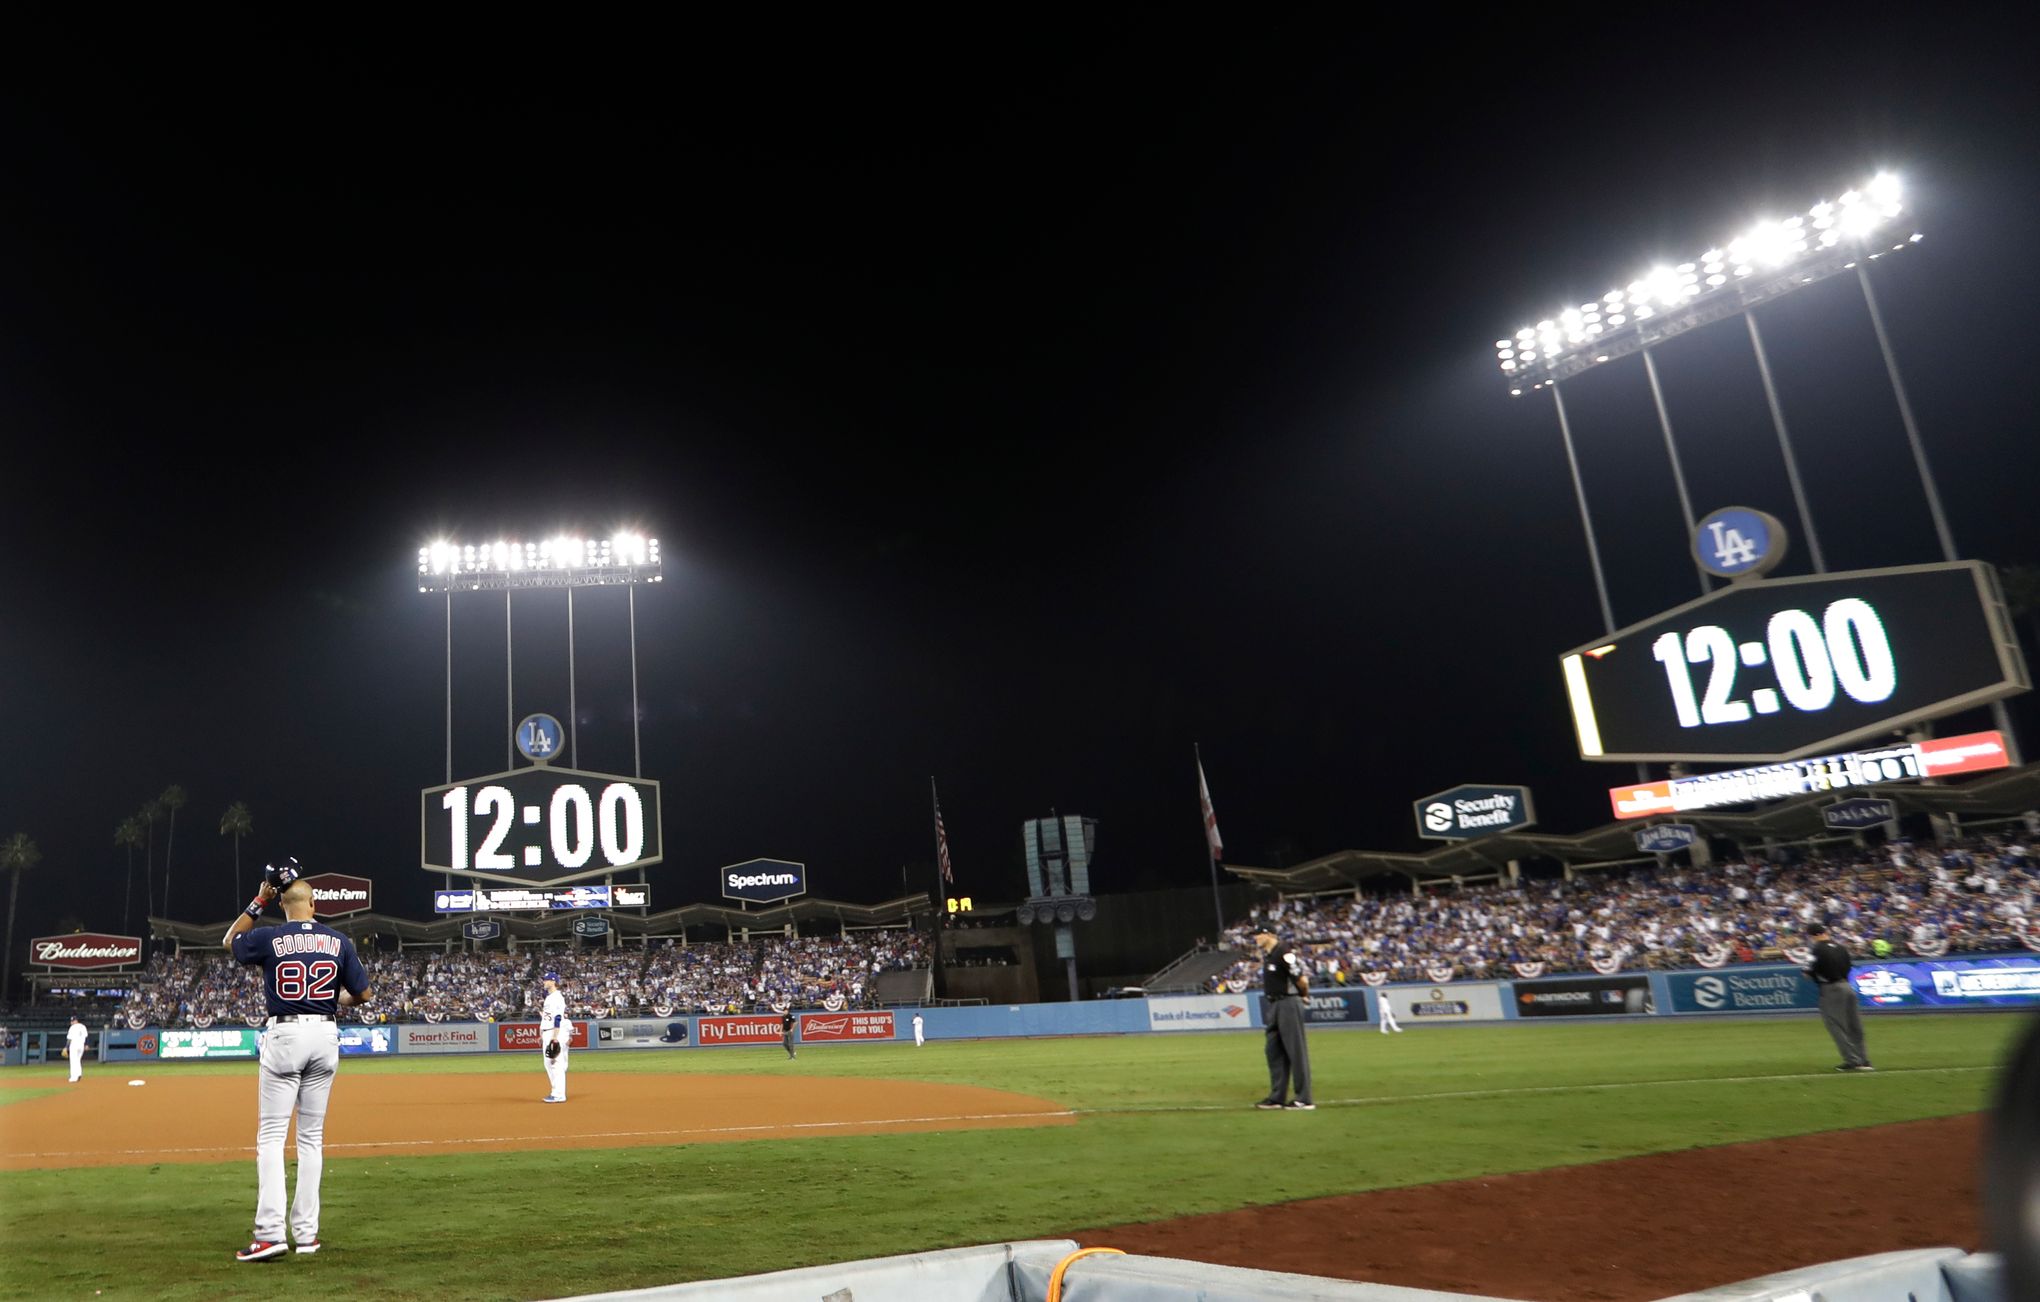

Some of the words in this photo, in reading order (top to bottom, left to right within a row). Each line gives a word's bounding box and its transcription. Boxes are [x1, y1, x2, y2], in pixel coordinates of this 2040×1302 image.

[1707, 520, 1756, 567] LA
[1652, 597, 1896, 728] 12:00
[528, 721, 552, 753] LA
[1454, 793, 1516, 814] Security
[442, 782, 645, 870] 12:00
[1459, 811, 1511, 829] Benefit
[728, 873, 794, 889] Spectrum
[36, 942, 138, 961] Budweiser
[272, 933, 341, 958] GOODWIN
[275, 960, 338, 1001] 82
[1728, 973, 1798, 990] Security
[1733, 989, 1794, 1007] Benefit
[852, 1017, 869, 1025] THIS
[870, 1015, 893, 1024] BUD'S
[1152, 1012, 1175, 1022] Bank
[1175, 1011, 1185, 1021] of
[1185, 1011, 1221, 1020] America
[516, 1028, 537, 1037] SAN
[701, 1023, 724, 1039] Fly
[727, 1022, 782, 1036] Emirate
[852, 1026, 867, 1034] FOR
[868, 1025, 886, 1034] YOU.
[141, 1040, 154, 1050] 76
